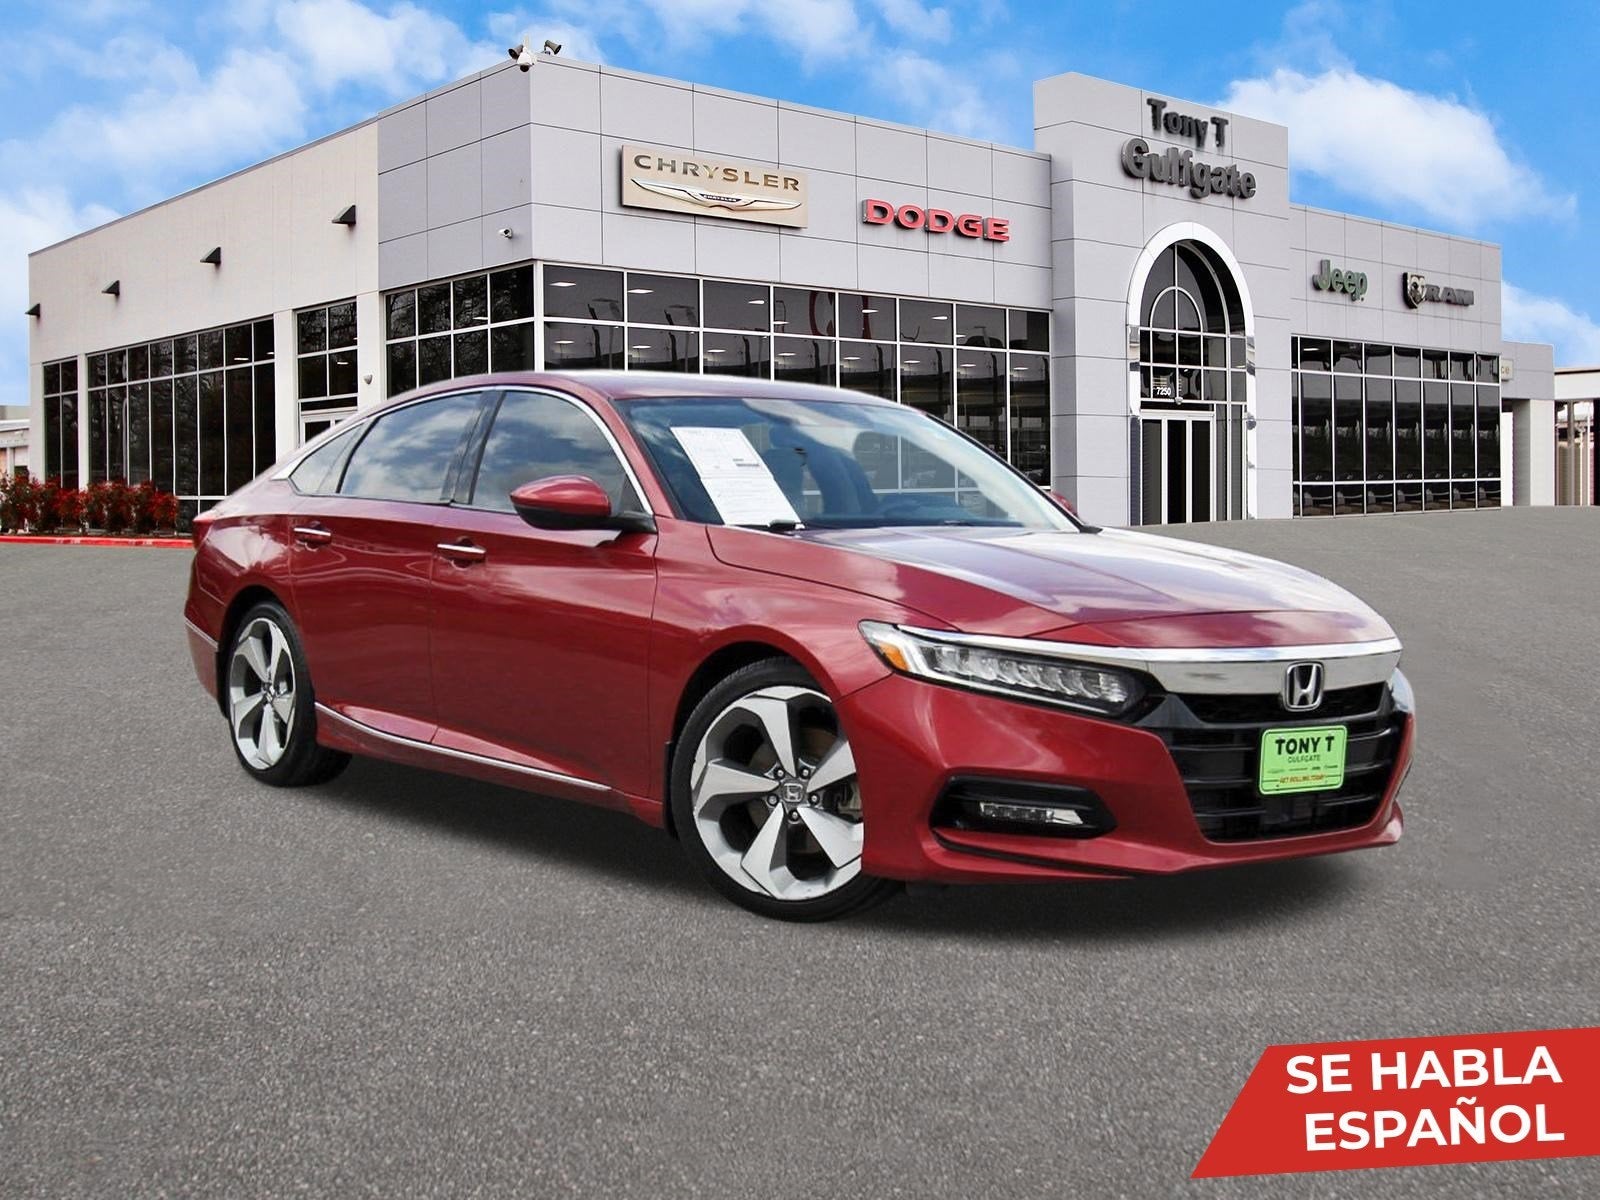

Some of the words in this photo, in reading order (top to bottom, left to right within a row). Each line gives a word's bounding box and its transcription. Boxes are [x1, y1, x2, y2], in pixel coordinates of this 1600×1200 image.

[1146, 98, 1209, 148] Tony
[1210, 116, 1229, 147] T
[633, 153, 801, 192] CHRYSLER
[1120, 137, 1257, 199] Gulfgate
[862, 198, 1011, 243] DODGE
[1312, 259, 1368, 301] Jeep
[1424, 284, 1475, 306] RAM
[1156, 386, 1171, 396] 7250
[1275, 737, 1321, 755] TONY
[1325, 736, 1335, 752] T
